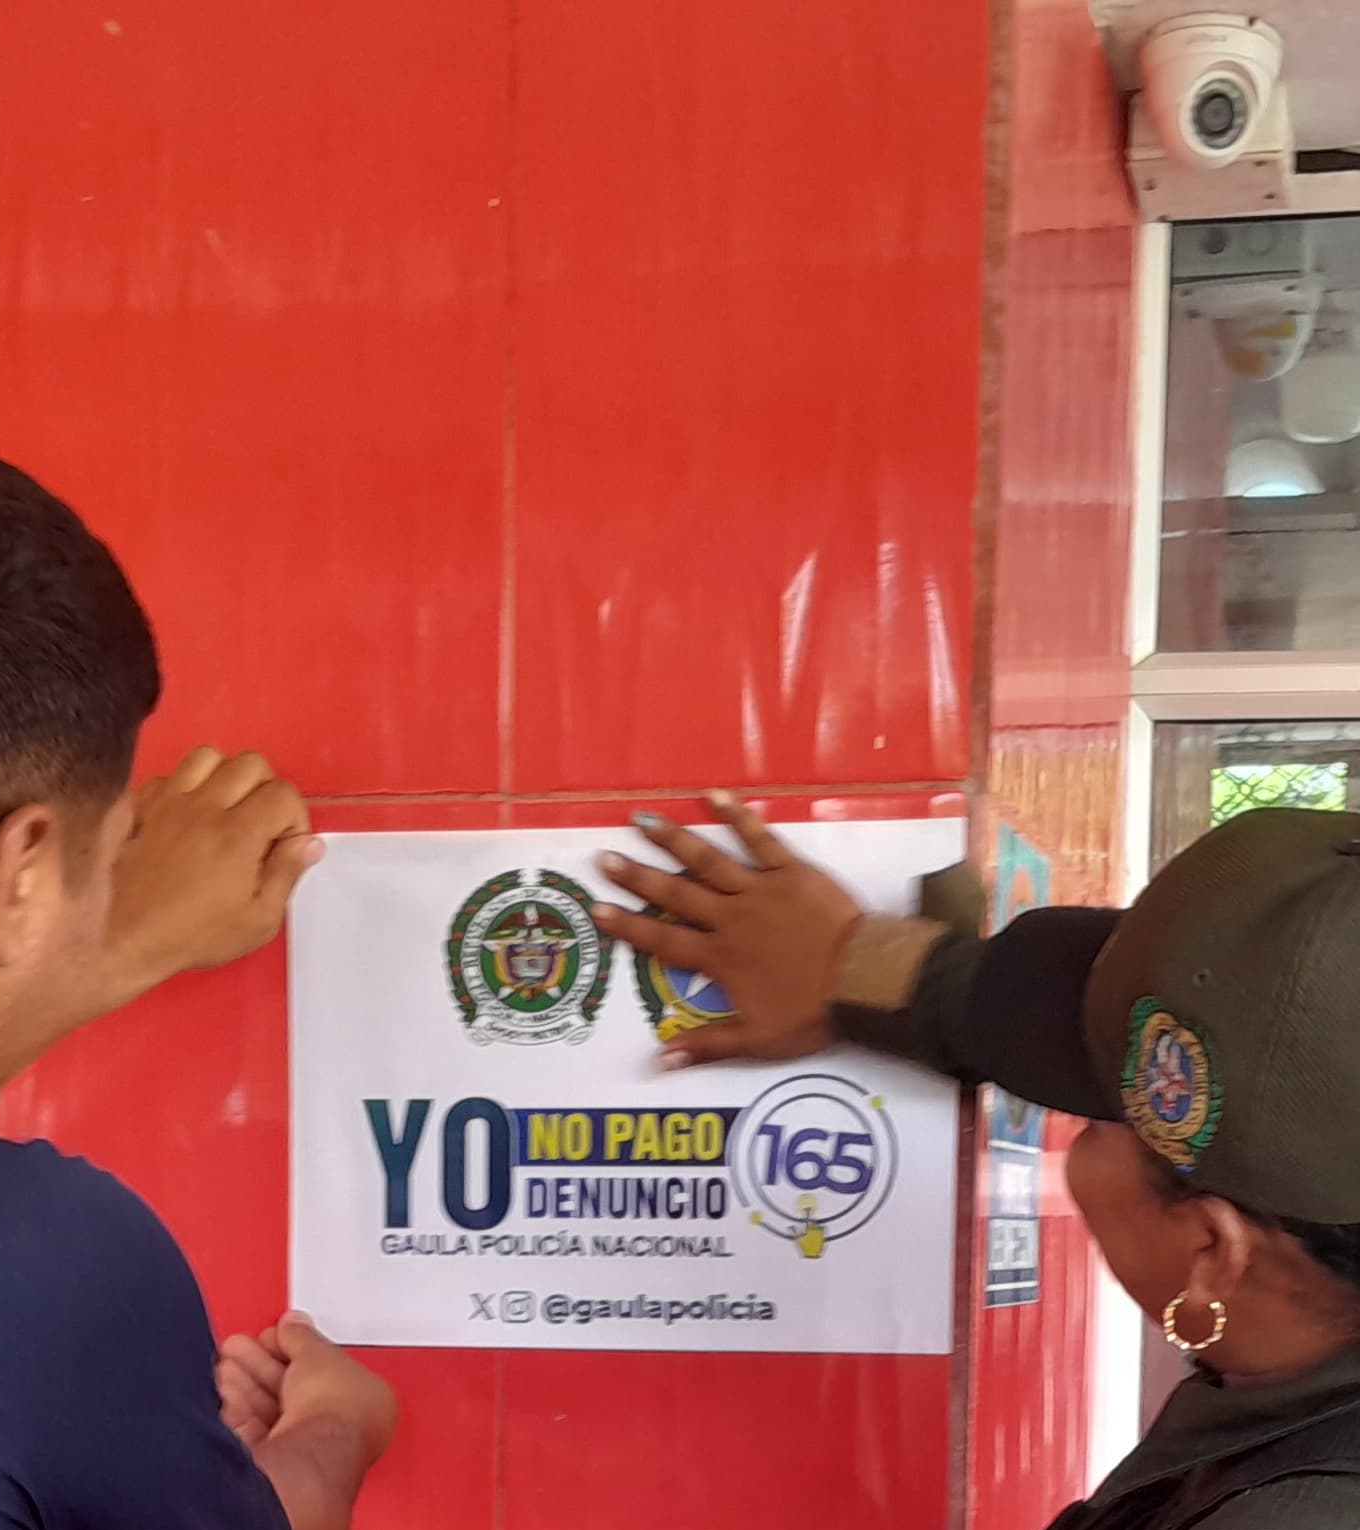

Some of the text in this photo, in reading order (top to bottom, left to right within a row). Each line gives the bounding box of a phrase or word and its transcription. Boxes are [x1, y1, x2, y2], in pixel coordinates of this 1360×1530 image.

[528, 1112, 723, 1161] NO PAGO
[755, 1122, 874, 1196] 165
[364, 1097, 512, 1231] YO
[527, 1177, 727, 1219] DENUNCIO
[380, 1229, 735, 1258] GAULA POLICÍA NACIONAL
